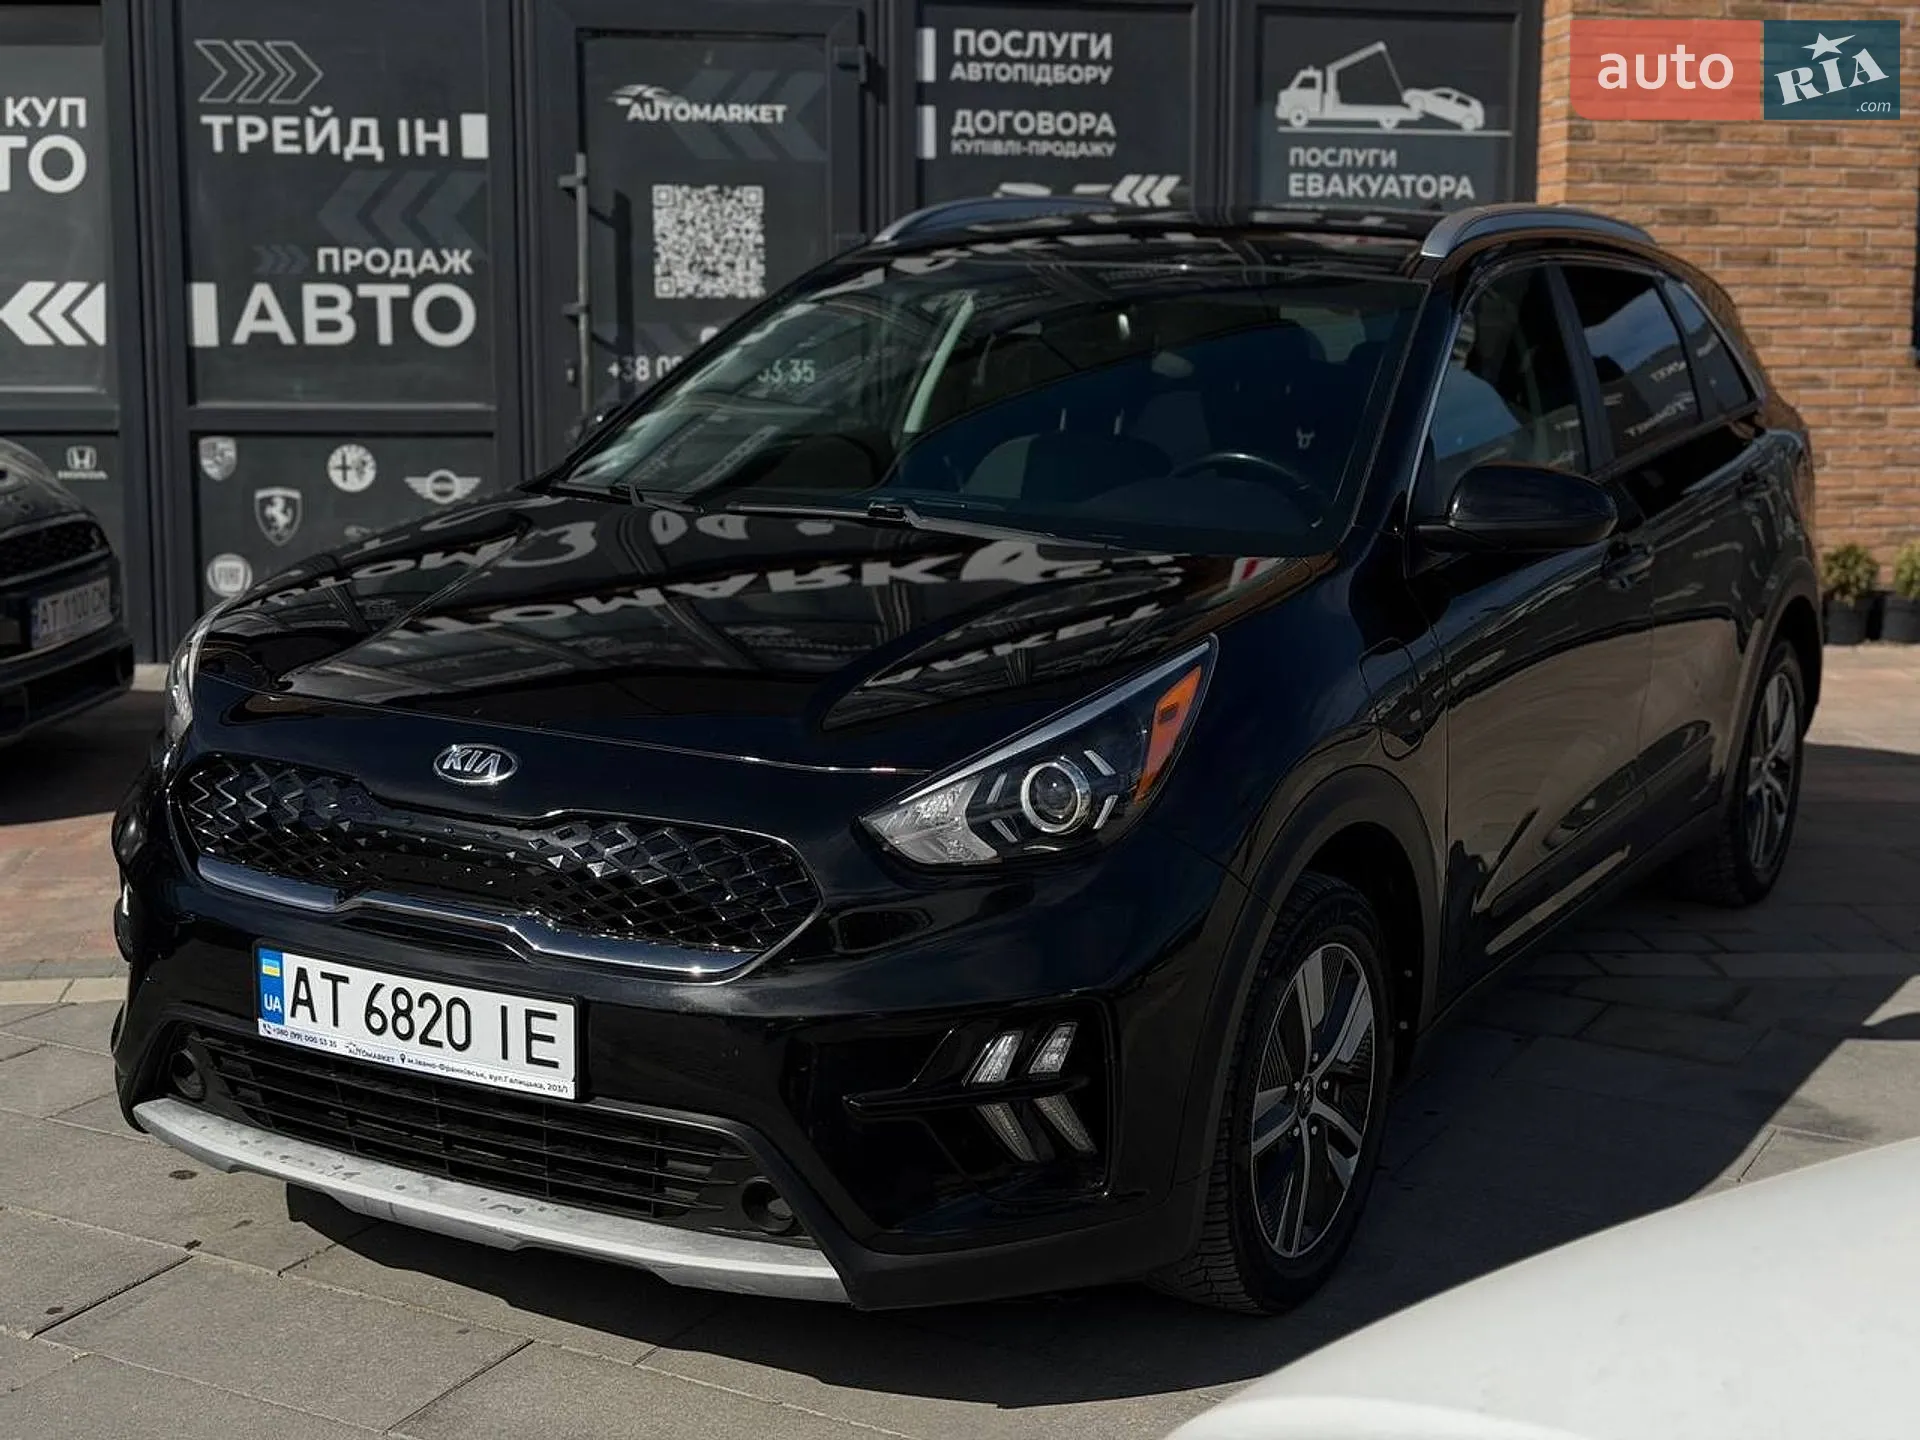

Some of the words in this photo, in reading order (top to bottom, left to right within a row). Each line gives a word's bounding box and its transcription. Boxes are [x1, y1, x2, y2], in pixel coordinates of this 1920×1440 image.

[953, 28, 1112, 60] ПОСЛУГИ
[950, 61, 1113, 86] АВТОПІДБОРУ
[5, 96, 87, 128] КУП
[627, 101, 788, 124] AUTOMARKET
[951, 109, 1117, 138] ДОГОВОРА
[200, 106, 385, 162] ТРЕЙД
[399, 118, 449, 157] ІН
[951, 138, 1116, 158] КУПІВЛІ-ПРОДАЖУ
[0, 134, 87, 193] ТО
[1289, 146, 1398, 168] ПОСЛУГИ
[1288, 172, 1476, 199] ЕВАКУАТОРА
[317, 247, 473, 277] ПРОДАЖ
[232, 282, 477, 347] АВТО
[442, 746, 501, 778] KIA
[264, 993, 283, 1014] UA
[290, 966, 350, 1029] AT
[364, 982, 472, 1053] 6820
[500, 1004, 560, 1070] IE
